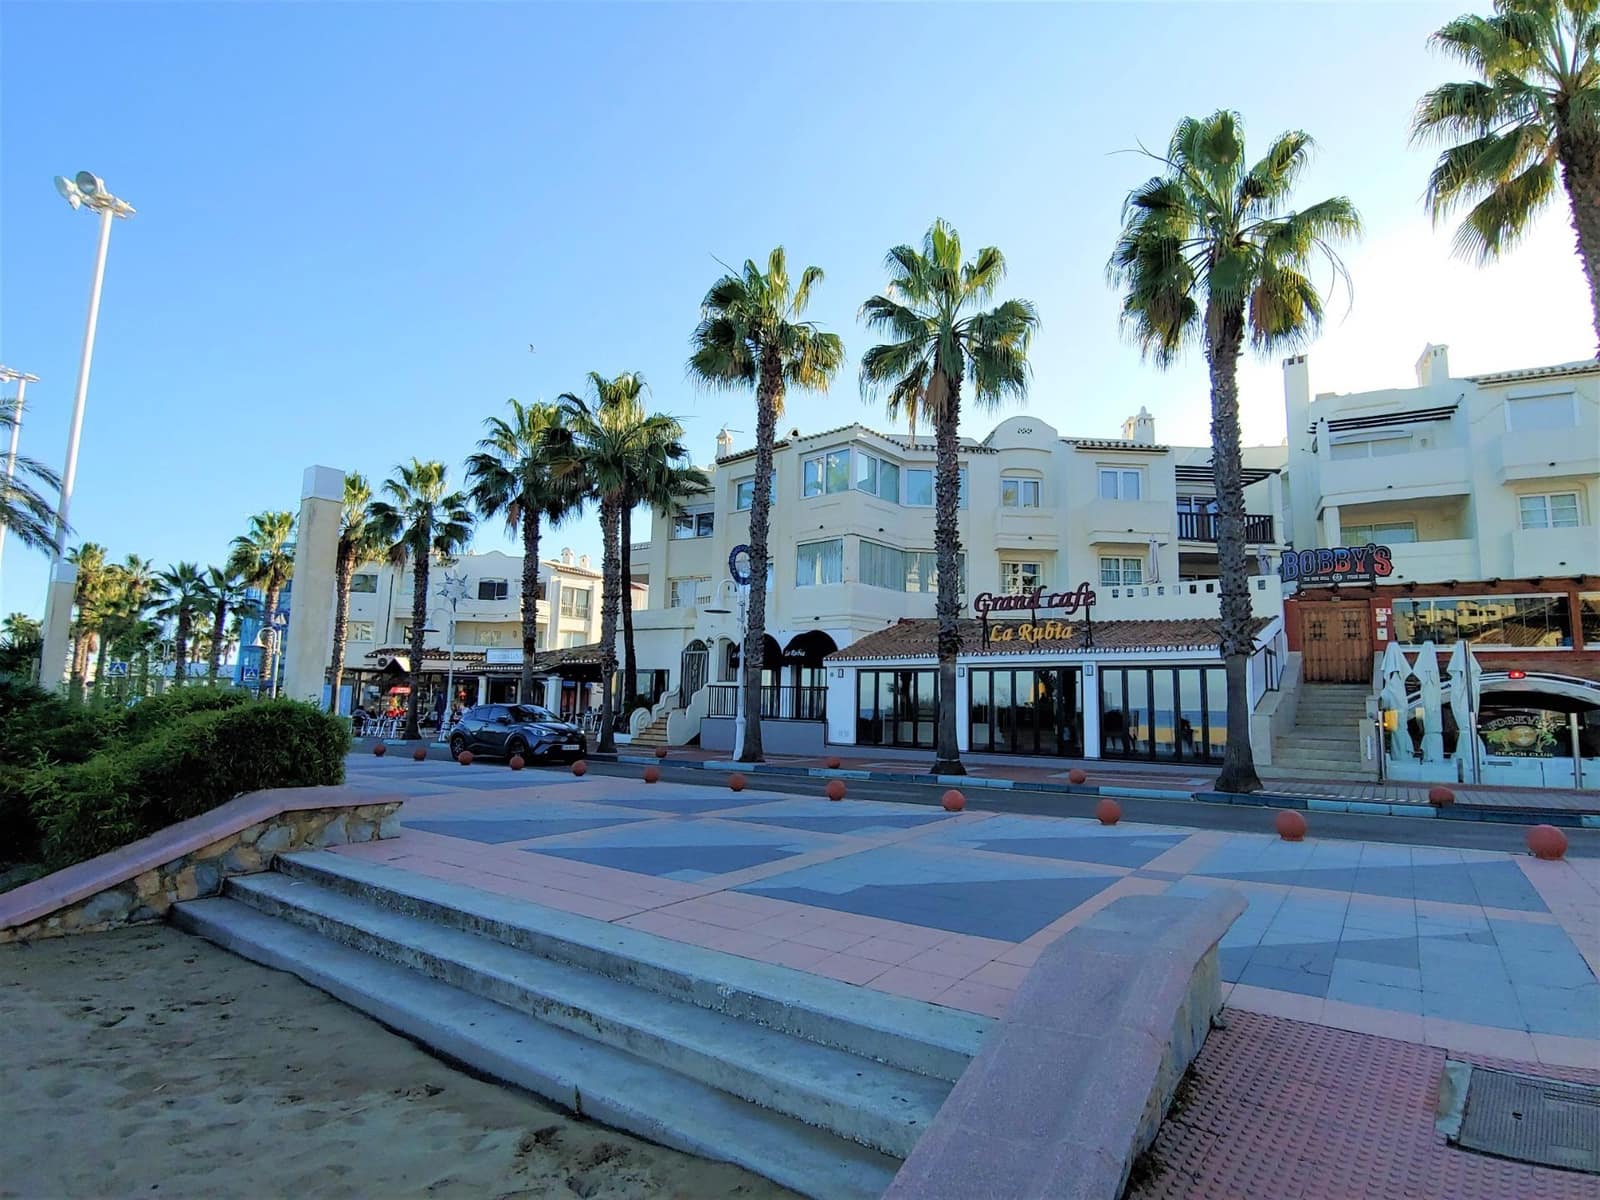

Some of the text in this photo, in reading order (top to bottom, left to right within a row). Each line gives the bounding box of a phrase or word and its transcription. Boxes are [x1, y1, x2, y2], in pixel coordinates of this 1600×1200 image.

[1282, 544, 1392, 581] BOBBY'S
[974, 585, 1047, 620] Grand
[990, 620, 1074, 643] La Rubia
